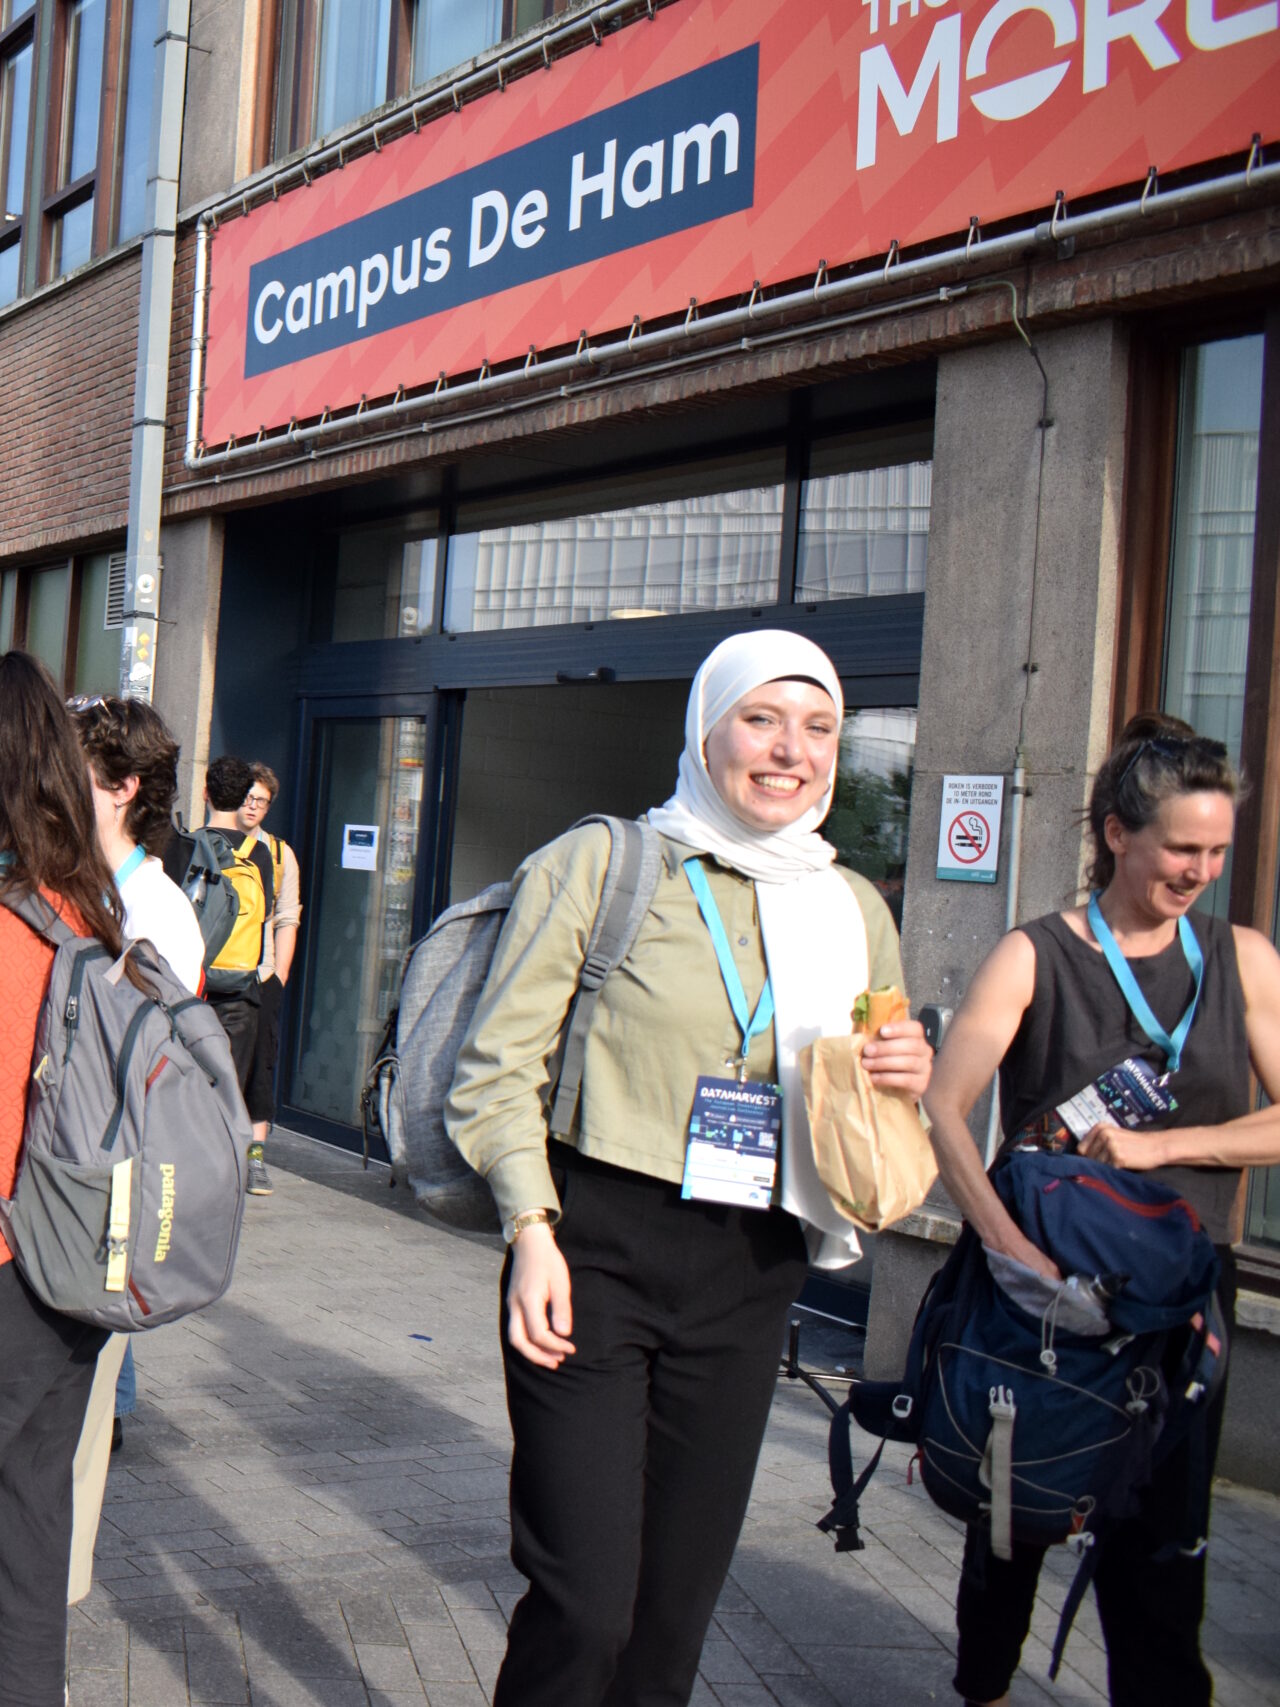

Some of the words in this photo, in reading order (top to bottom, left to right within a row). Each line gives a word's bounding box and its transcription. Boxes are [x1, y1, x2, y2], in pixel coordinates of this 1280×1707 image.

[254, 226, 451, 345] Campus
[468, 190, 548, 268] De
[568, 111, 740, 231] Ham
[700, 1087, 777, 1105] DATAHARVEST
[1124, 1058, 1168, 1110] DATAHARVEST
[154, 1164, 175, 1262] patagonia
